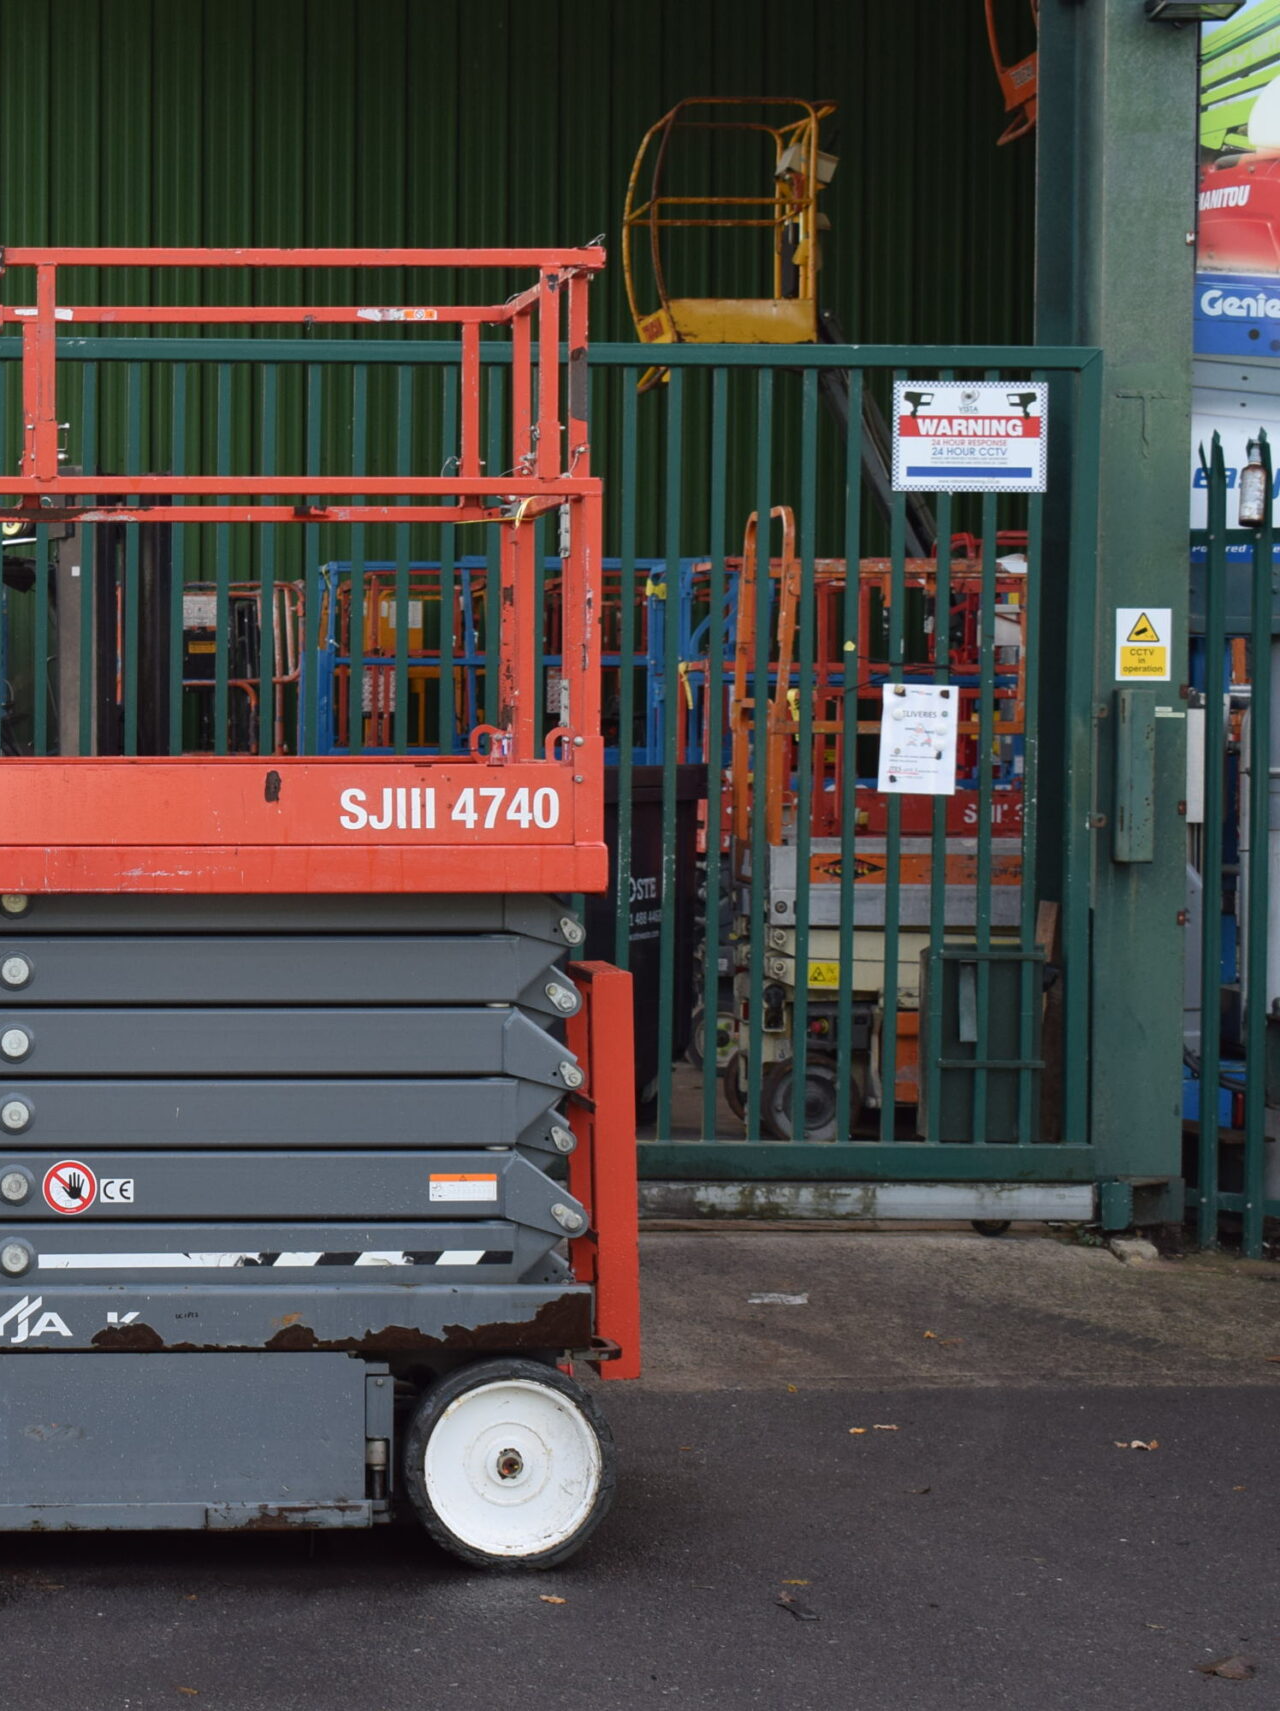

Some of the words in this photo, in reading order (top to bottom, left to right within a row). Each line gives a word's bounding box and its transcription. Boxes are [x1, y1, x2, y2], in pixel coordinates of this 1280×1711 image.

[1200, 289, 1280, 319] Genie
[916, 418, 1024, 437] WARNING
[967, 439, 1007, 447] RESPONSE
[931, 447, 944, 457] 24
[946, 447, 977, 457] HOUR
[978, 447, 1009, 457] CCTV
[1129, 648, 1155, 656] CCTV
[1122, 665, 1163, 673] operation
[902, 710, 938, 719] ELIVERIES
[339, 787, 436, 830] SJIII
[451, 787, 560, 829] 4740
[103, 1180, 131, 1200] CE
